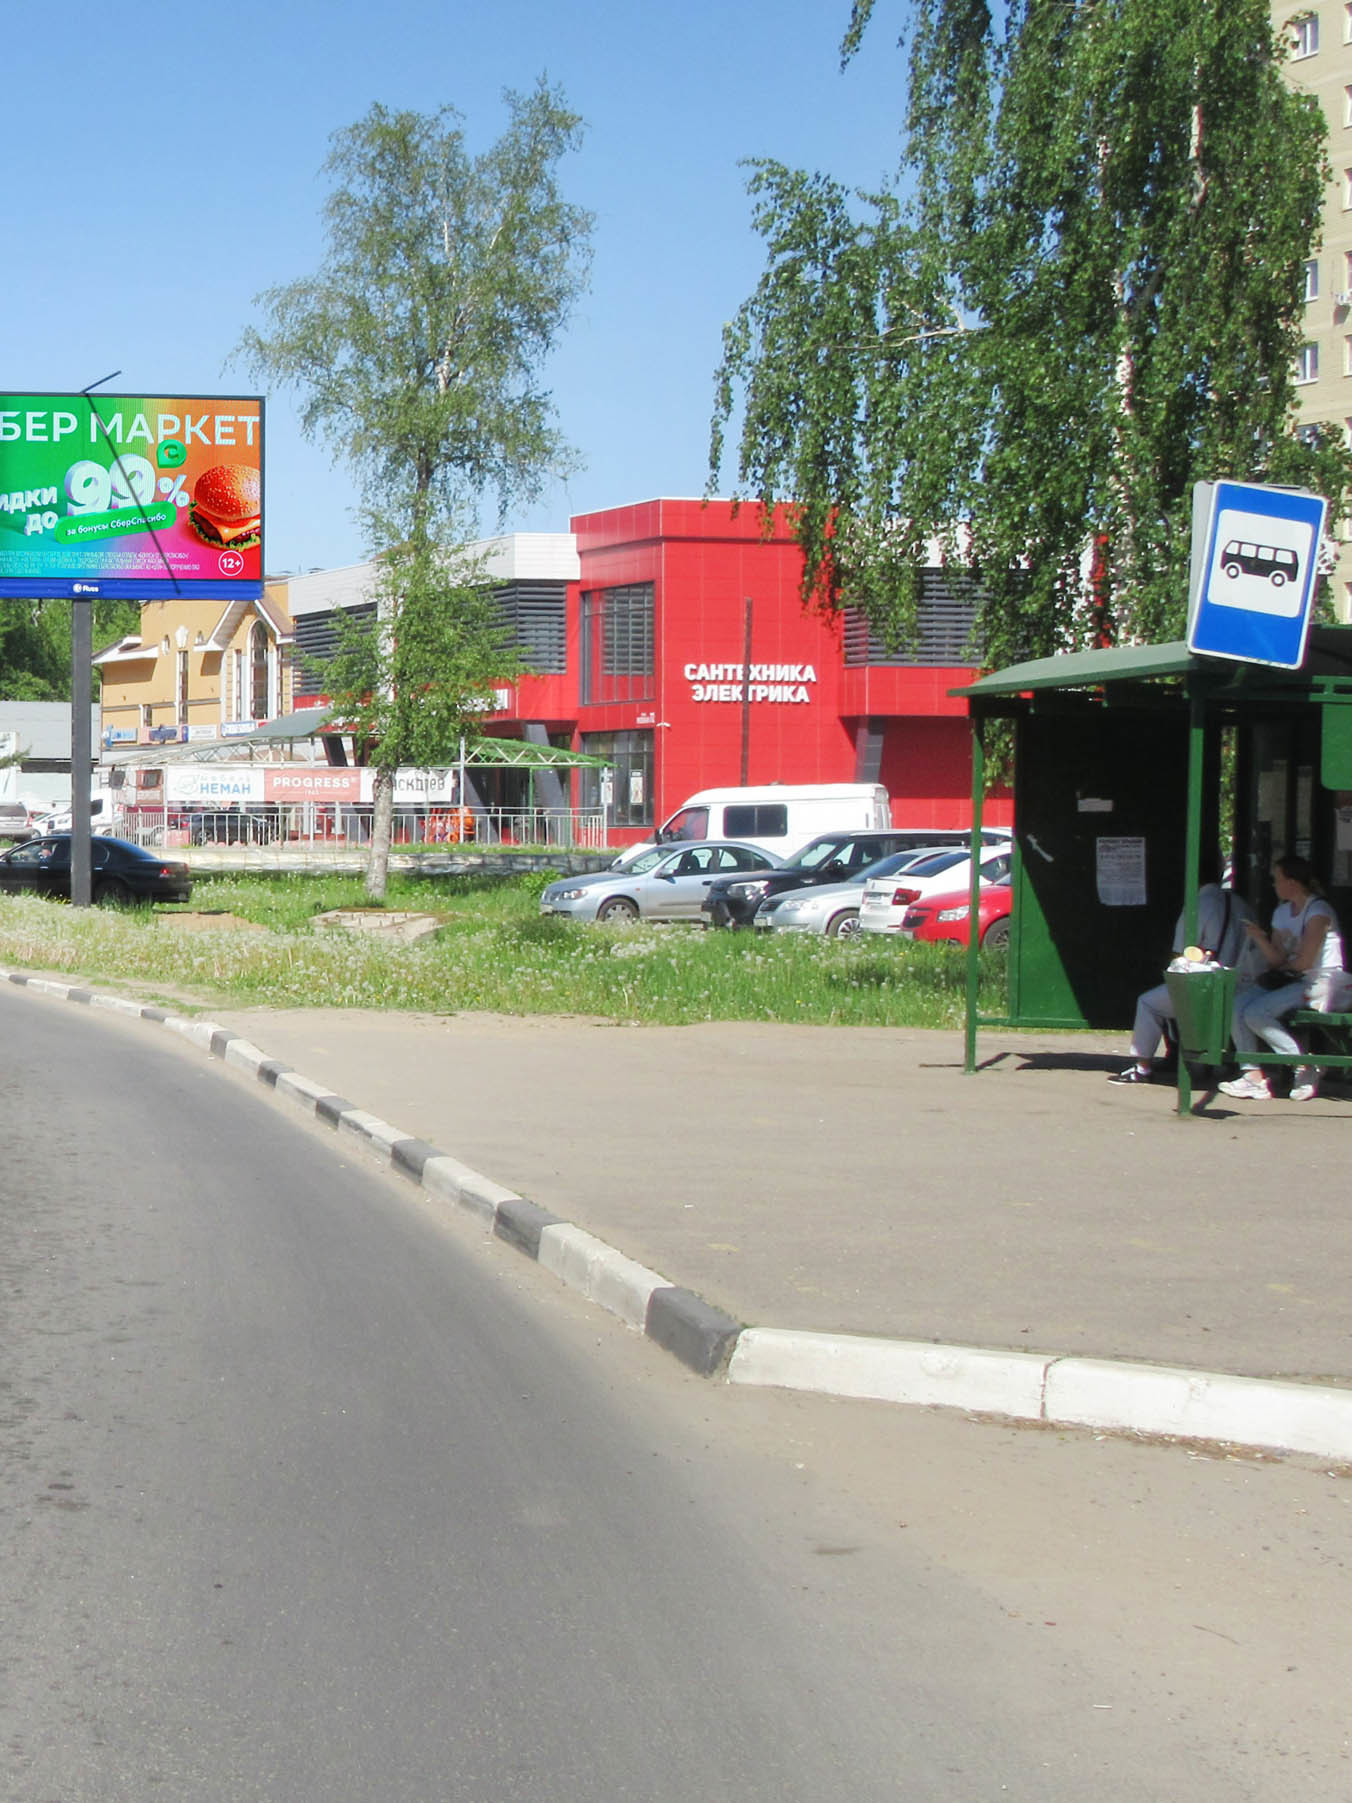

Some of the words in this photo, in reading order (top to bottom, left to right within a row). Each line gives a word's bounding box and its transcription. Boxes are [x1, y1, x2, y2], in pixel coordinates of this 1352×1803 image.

[90, 412, 260, 446] МАРКЕТ
[24, 510, 59, 536] до
[77, 522, 108, 534] бонусы
[222, 558, 241, 569] 12+
[684, 663, 816, 682] САНТЕХНИКА
[692, 684, 810, 703] ЭЛЕКТРИКА
[200, 783, 251, 794] НЕМАН
[273, 777, 350, 788] PROGRESS
